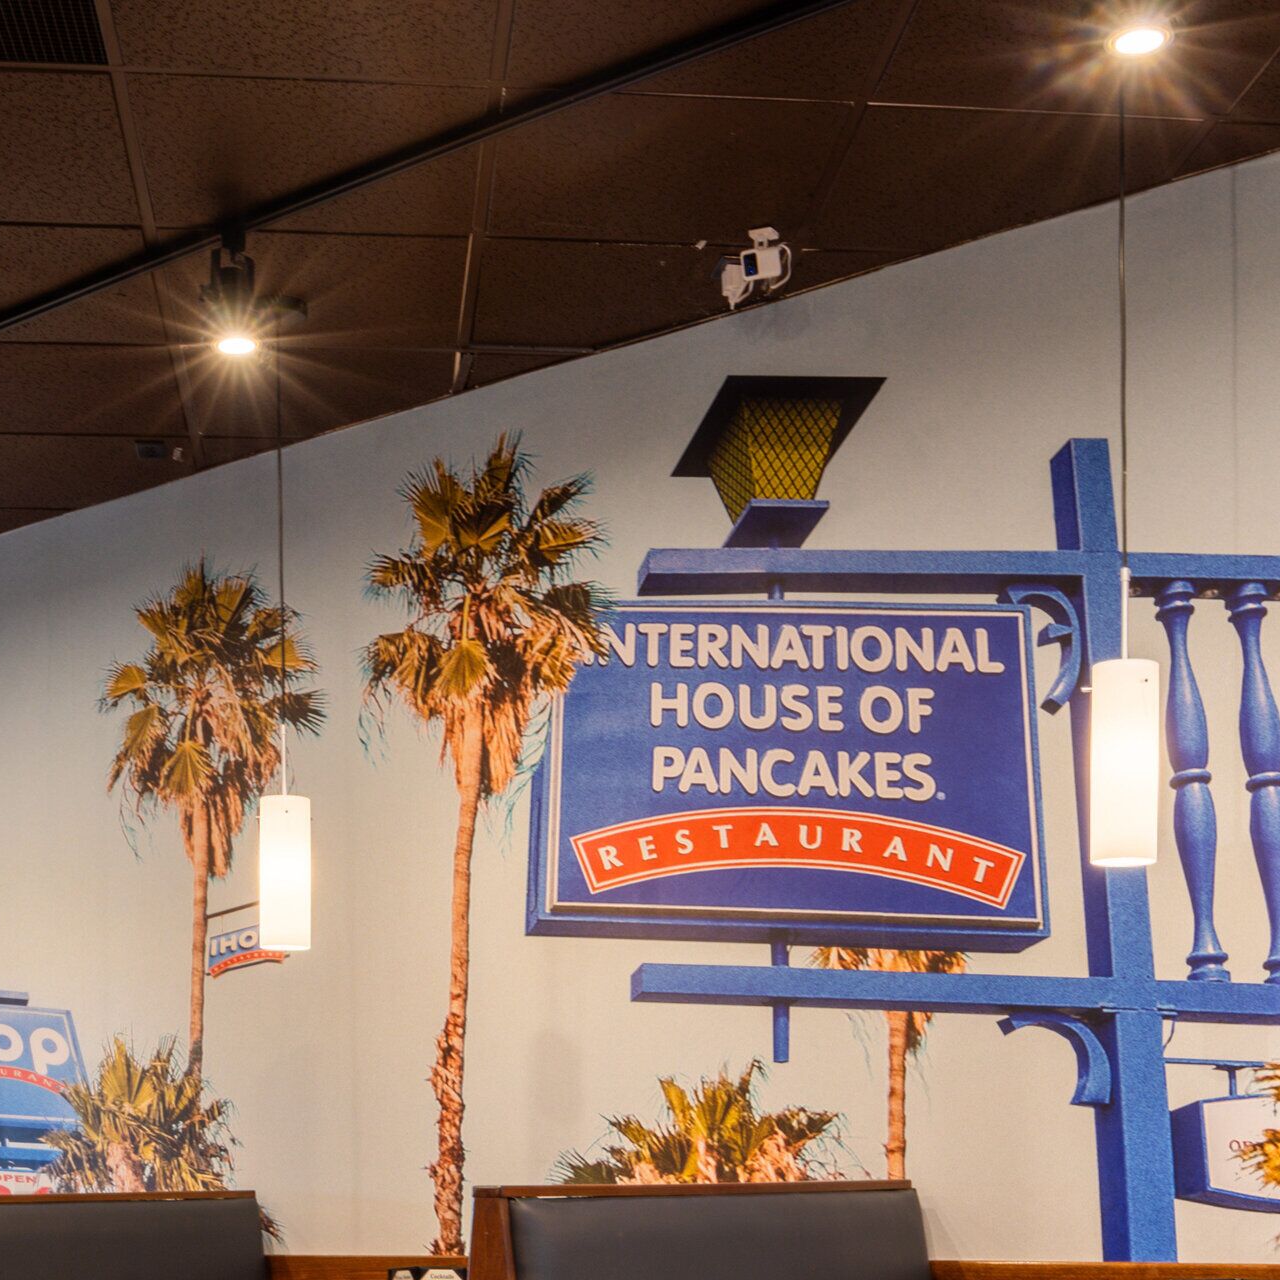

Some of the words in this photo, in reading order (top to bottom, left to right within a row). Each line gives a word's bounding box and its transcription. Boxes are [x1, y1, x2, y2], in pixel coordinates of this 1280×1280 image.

[583, 622, 1005, 674] NTERNATIONAL
[650, 682, 844, 732] HOUSE
[859, 686, 935, 734] OF
[599, 824, 996, 883] RESTAURANT
[210, 930, 258, 957] IHO
